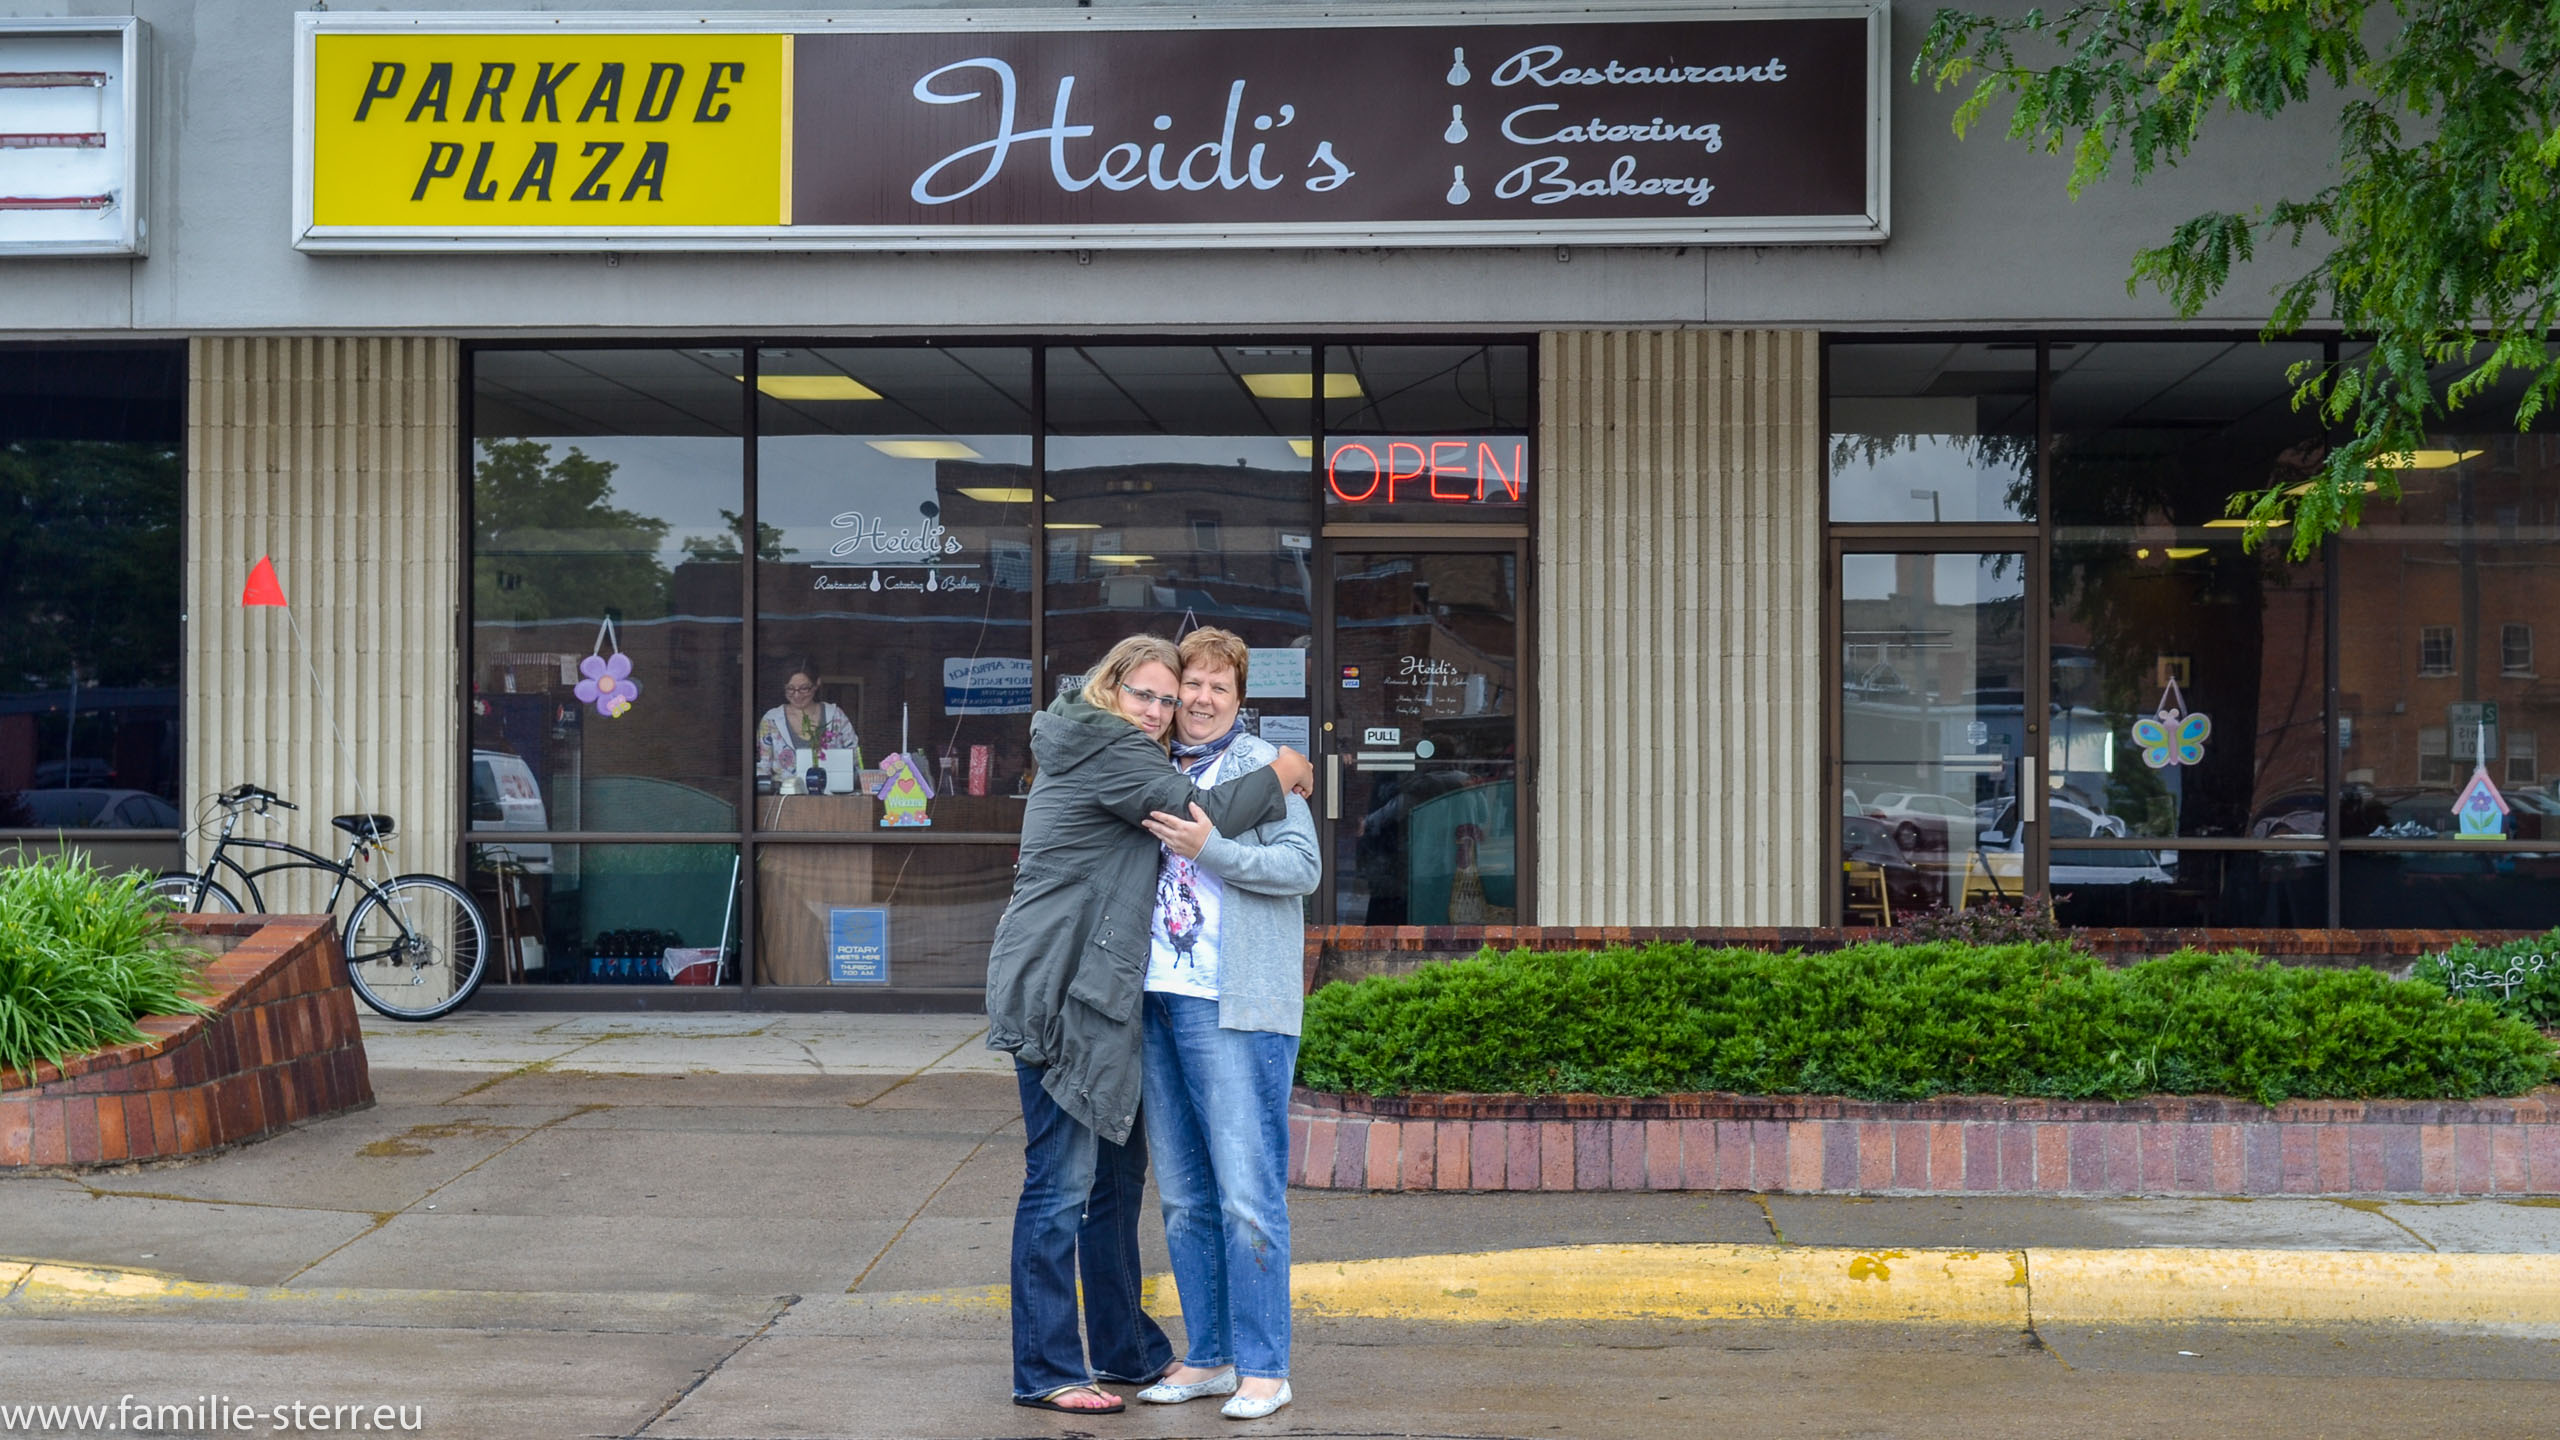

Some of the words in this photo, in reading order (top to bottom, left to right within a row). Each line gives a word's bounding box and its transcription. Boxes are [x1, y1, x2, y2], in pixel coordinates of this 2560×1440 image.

[1491, 45, 1787, 88] Restaurant
[354, 61, 746, 124] PARKADE
[911, 57, 1355, 206] Heidi's
[1501, 103, 1722, 153] Catering
[410, 141, 670, 203] PLAZA
[1495, 155, 1715, 206] Bakery
[1328, 441, 1522, 503] OPEN
[830, 511, 963, 556] Heidi's
[1400, 655, 1458, 675] Heidi's
[1367, 731, 1396, 741] PULL
